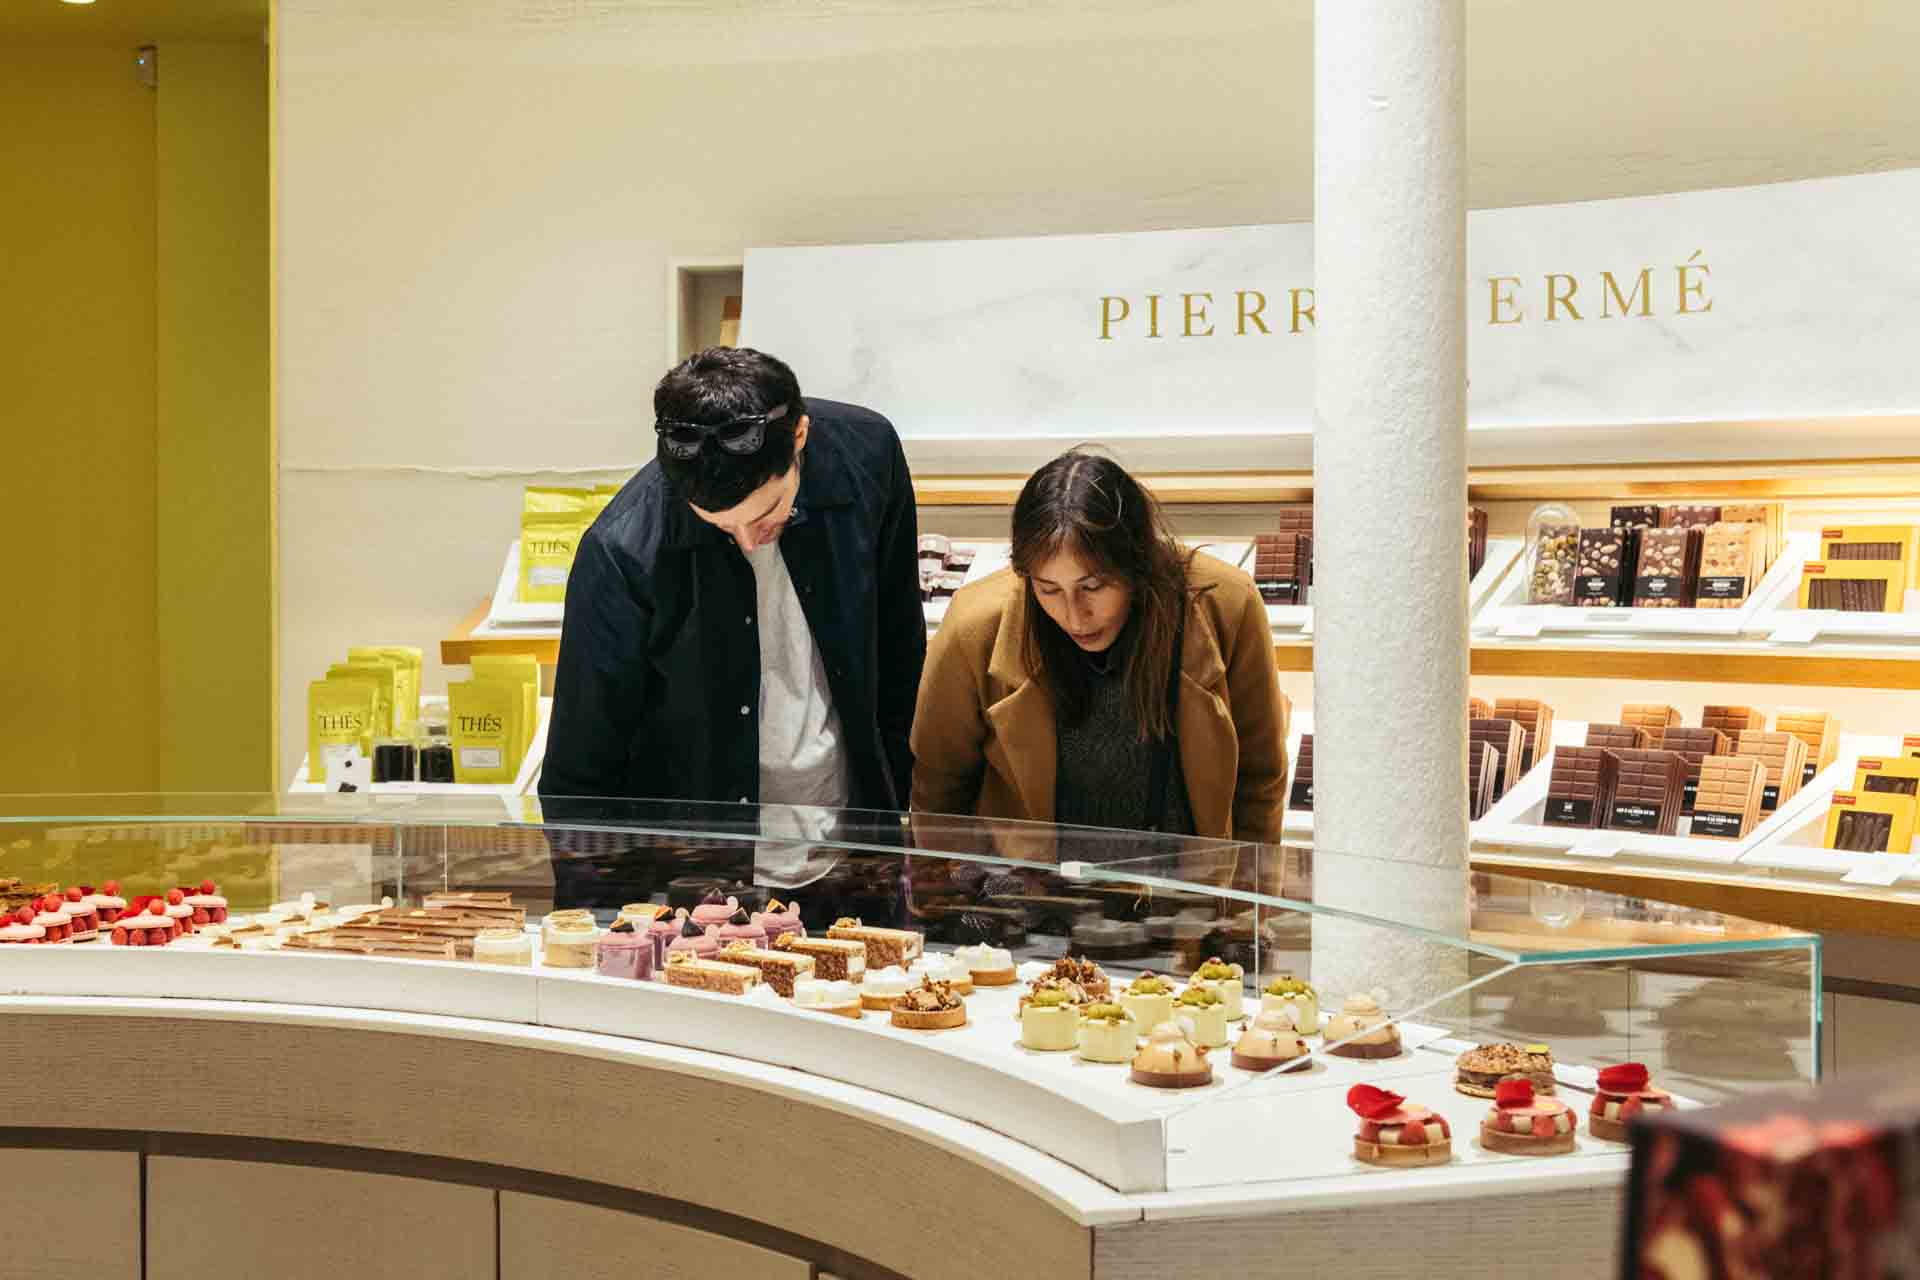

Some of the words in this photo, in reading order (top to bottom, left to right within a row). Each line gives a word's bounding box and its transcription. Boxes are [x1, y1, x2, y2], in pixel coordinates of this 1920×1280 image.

[1096, 286, 1316, 340] PIERR
[1486, 249, 1714, 325] ERMÉ
[319, 712, 363, 731] THÉS
[458, 712, 503, 732] THÉS
